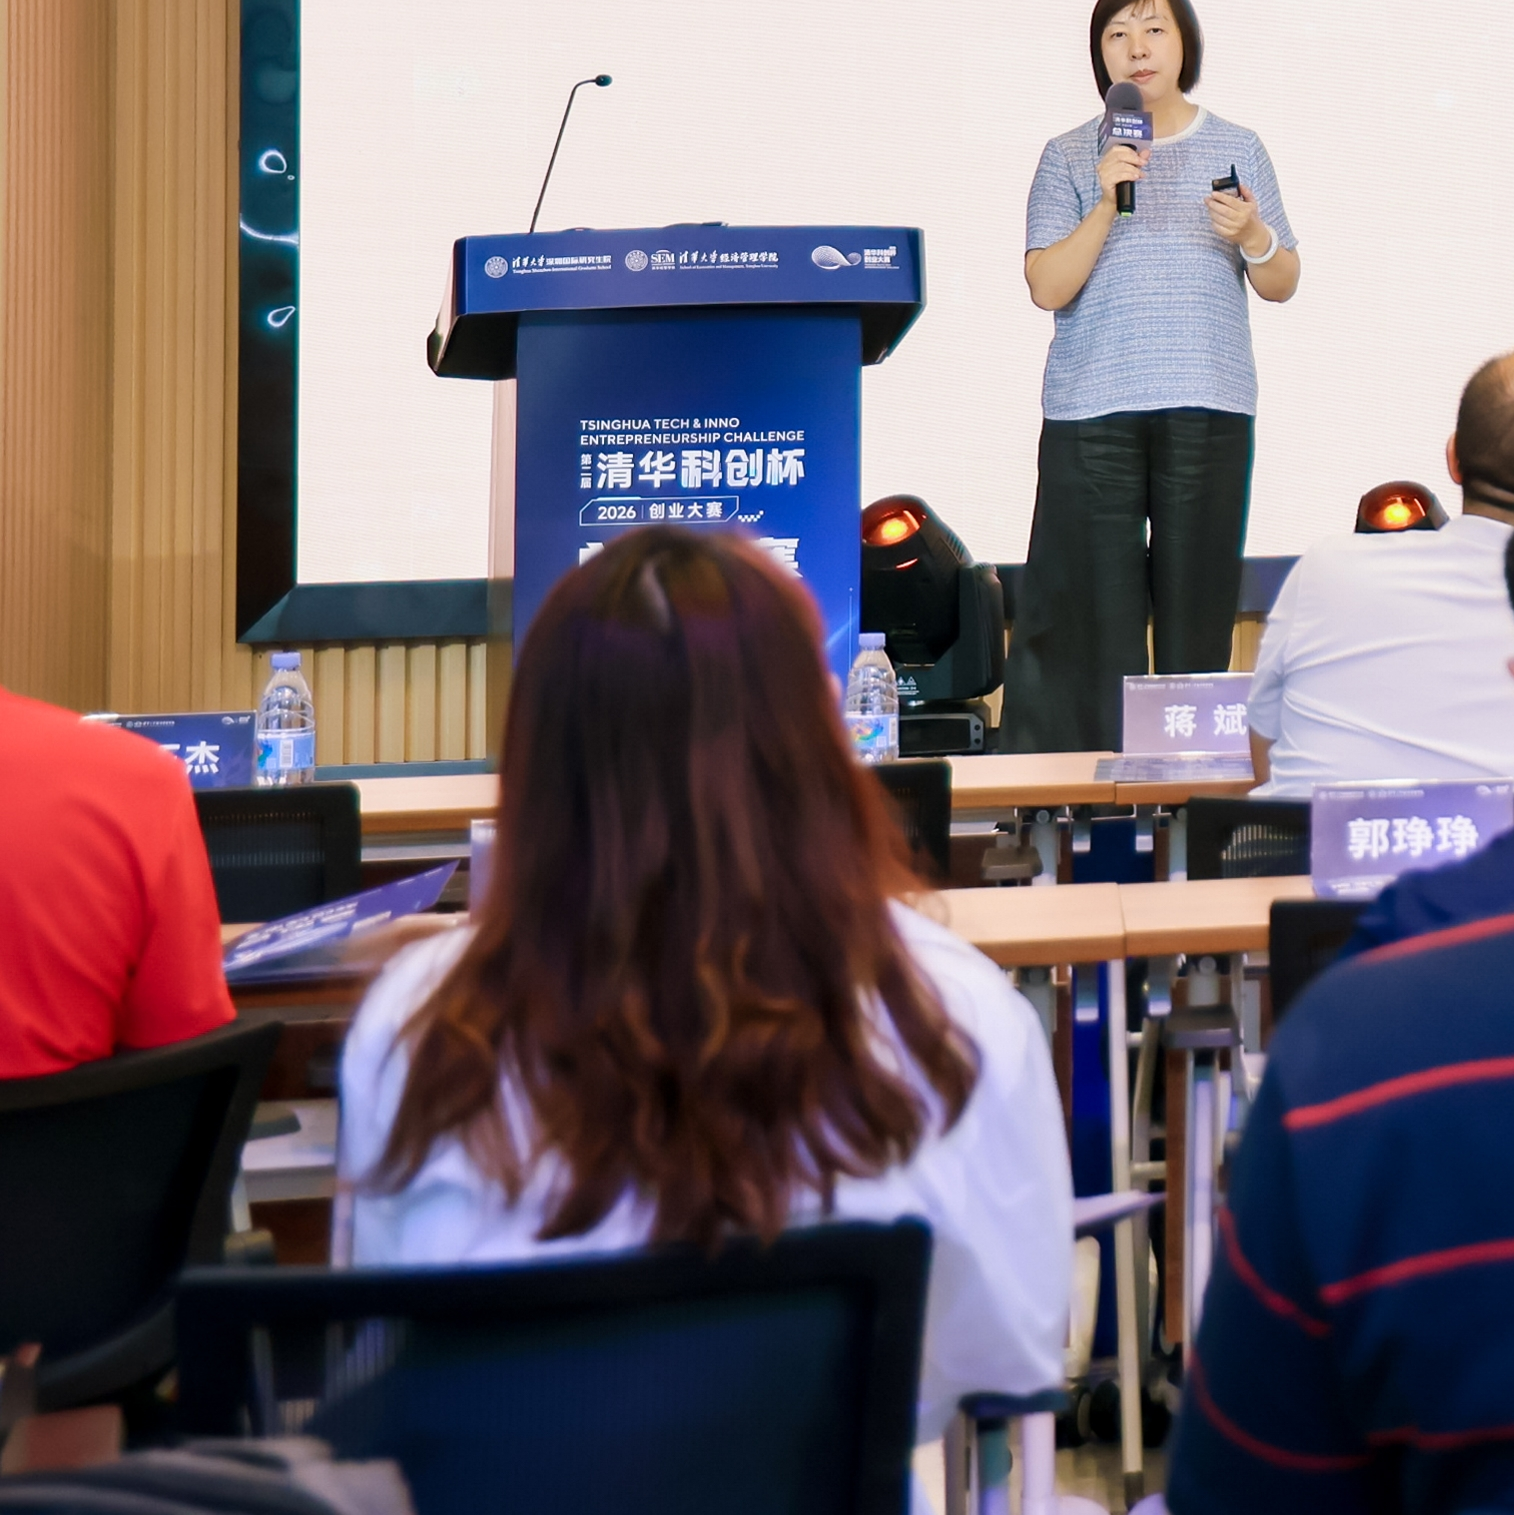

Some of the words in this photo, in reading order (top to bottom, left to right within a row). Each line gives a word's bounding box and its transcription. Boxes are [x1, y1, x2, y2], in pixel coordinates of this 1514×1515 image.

[651, 252, 676, 263] SEM
[580, 419, 651, 431] TSINGHUA
[654, 418, 690, 429] TECH
[693, 418, 701, 429] &
[704, 417, 740, 429] INNO
[580, 432, 721, 446] ENTREPRENEURSHIP
[723, 430, 805, 443] CHALLENGE
[580, 453, 593, 489] 第二届
[596, 447, 805, 489] 清华科创杯
[597, 505, 637, 520] 2026
[648, 502, 723, 519] 创业大赛
